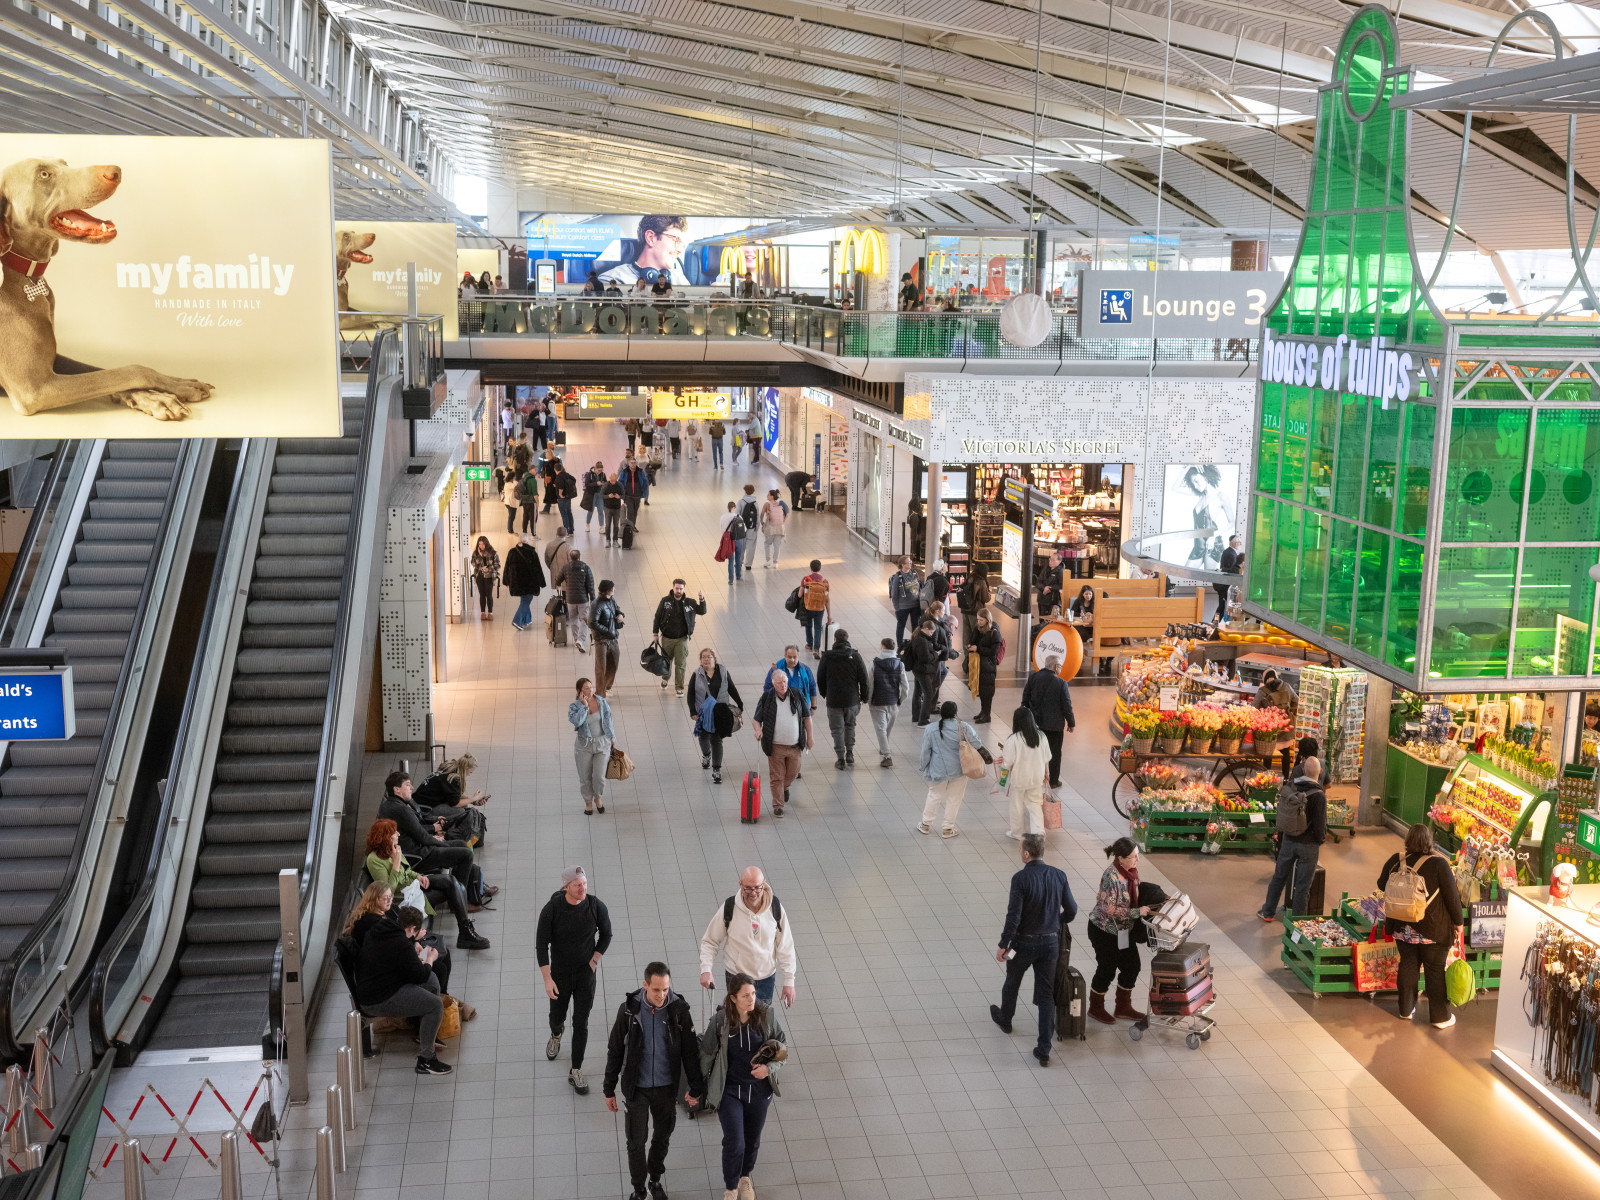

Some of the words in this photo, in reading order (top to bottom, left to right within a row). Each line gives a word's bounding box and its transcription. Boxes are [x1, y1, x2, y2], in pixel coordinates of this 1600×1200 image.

[154, 299, 212, 309] HANDMADE
[216, 299, 228, 309] IN
[233, 299, 262, 309] ITALY
[1142, 295, 1236, 322] Lounge
[1244, 288, 1268, 326] 3
[176, 312, 215, 328] With
[217, 314, 243, 328] love
[1261, 327, 1319, 387] house
[1320, 333, 1348, 391] of
[1347, 336, 1413, 410] tulips
[963, 439, 1056, 454] VICTORIA'S
[1062, 439, 1124, 454] SECRET
[1038, 640, 1048, 652] Say
[1048, 643, 1065, 654] Cheese
[1472, 904, 1507, 917] HOLLAN
